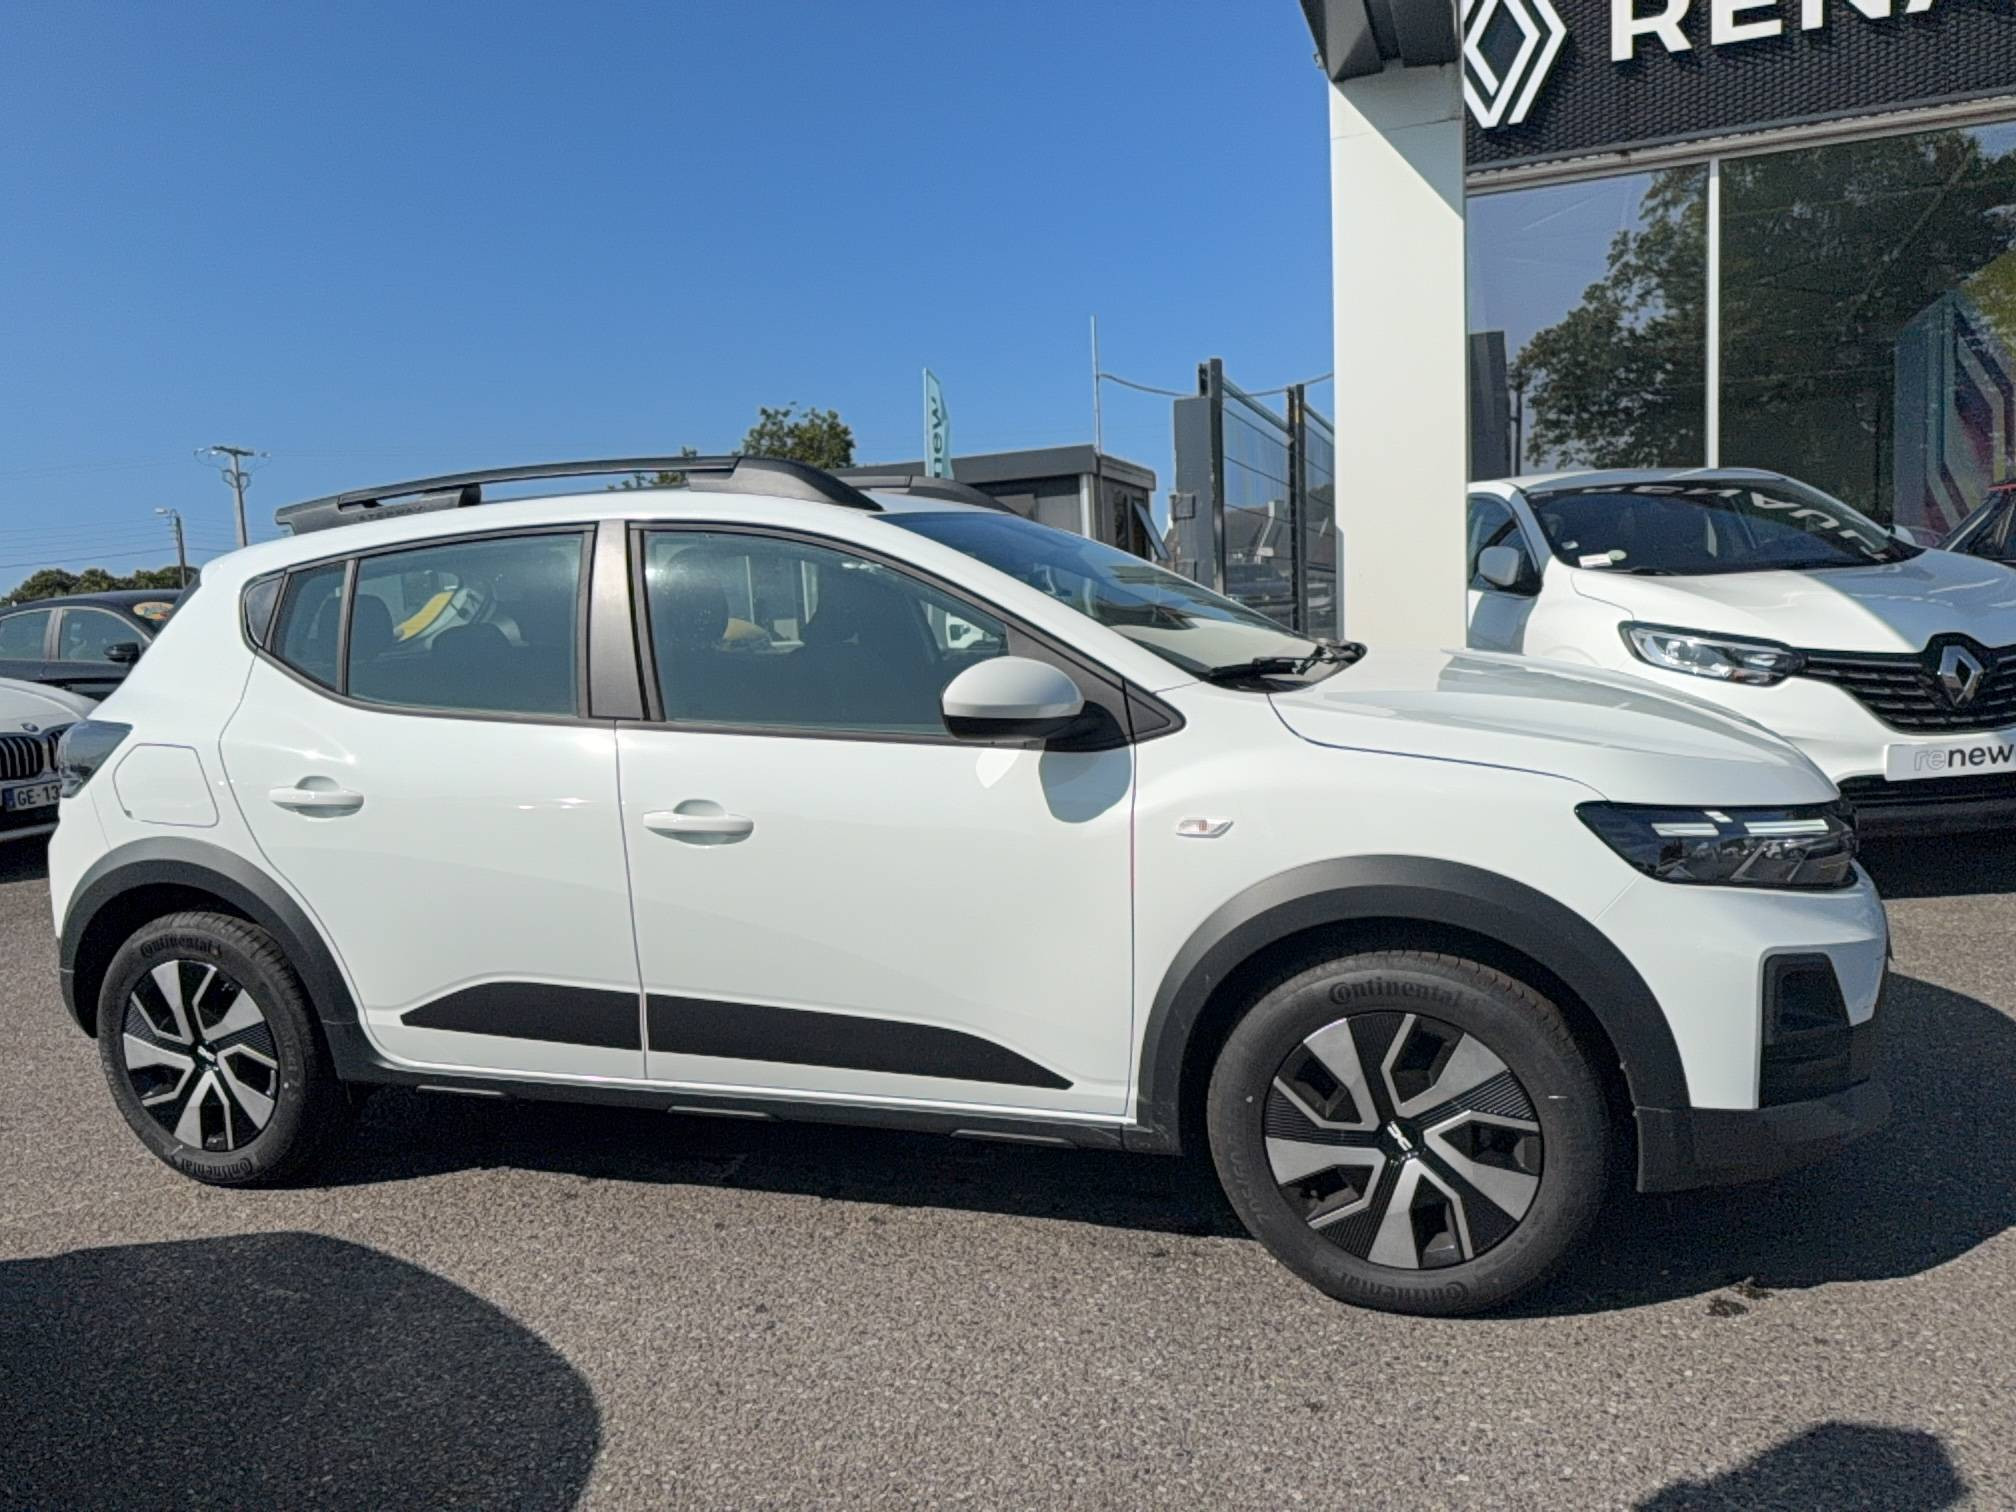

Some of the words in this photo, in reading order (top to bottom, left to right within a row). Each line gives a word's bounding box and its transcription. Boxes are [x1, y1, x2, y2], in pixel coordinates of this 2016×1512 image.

[1611, 0, 1935, 61] RE
[1913, 743, 2015, 772] renew
[17, 784, 62, 807] GE-13
[1329, 976, 1464, 1006] Continental
